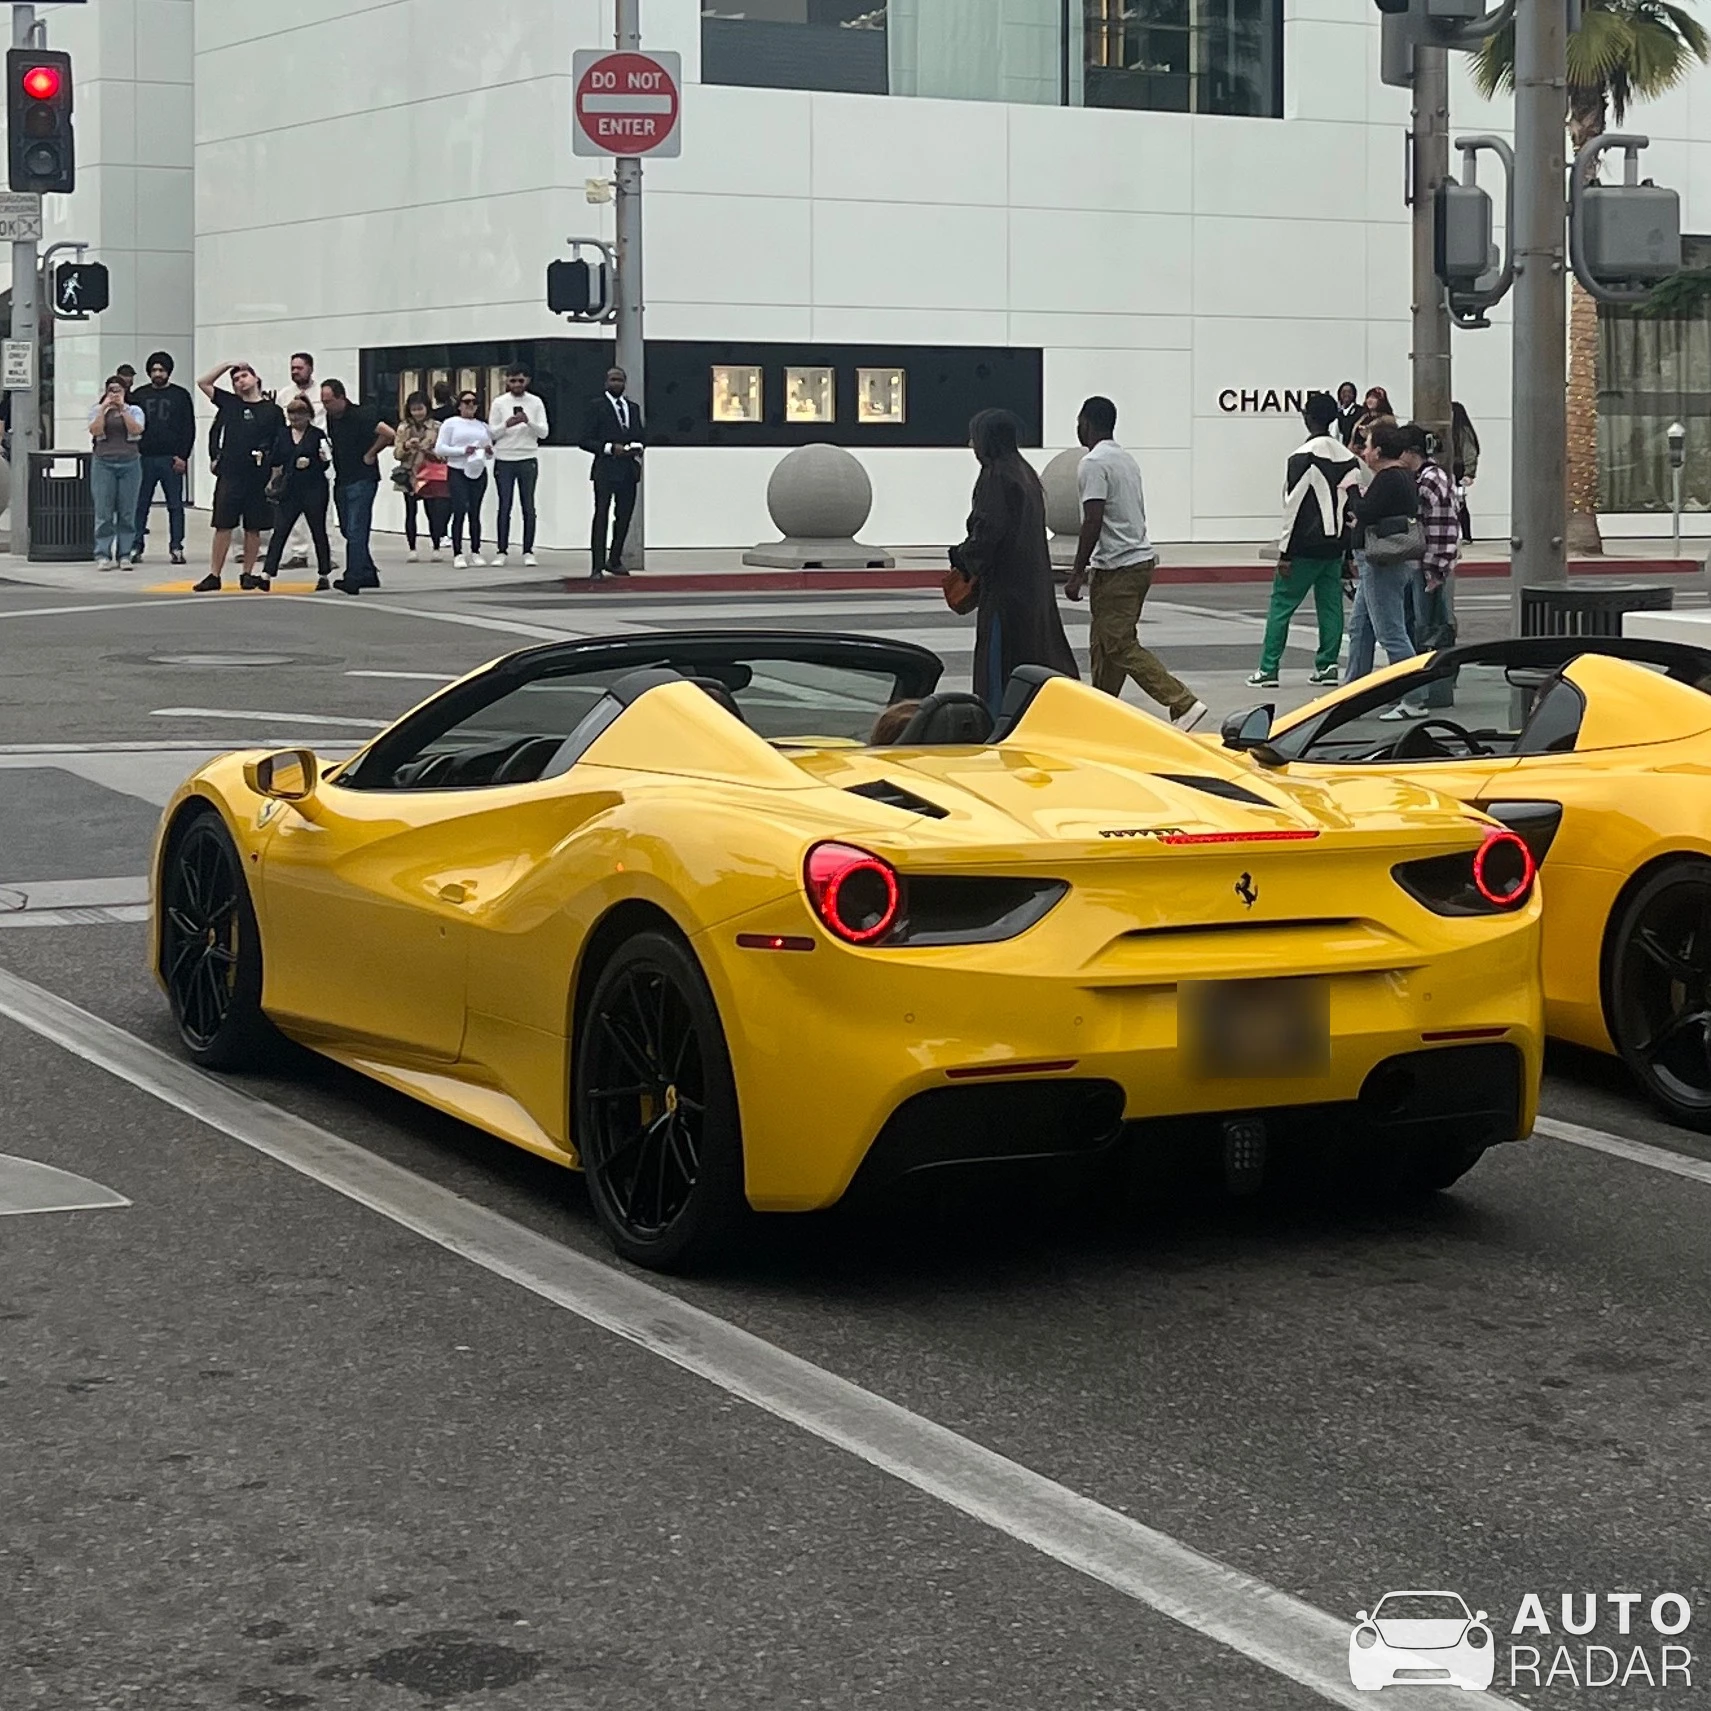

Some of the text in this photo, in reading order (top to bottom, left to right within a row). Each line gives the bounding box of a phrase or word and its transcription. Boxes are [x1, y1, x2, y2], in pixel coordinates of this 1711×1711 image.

[591, 71, 663, 90] DO NOT
[598, 118, 656, 136] ENTER
[1218, 389, 1331, 413] CHAN
